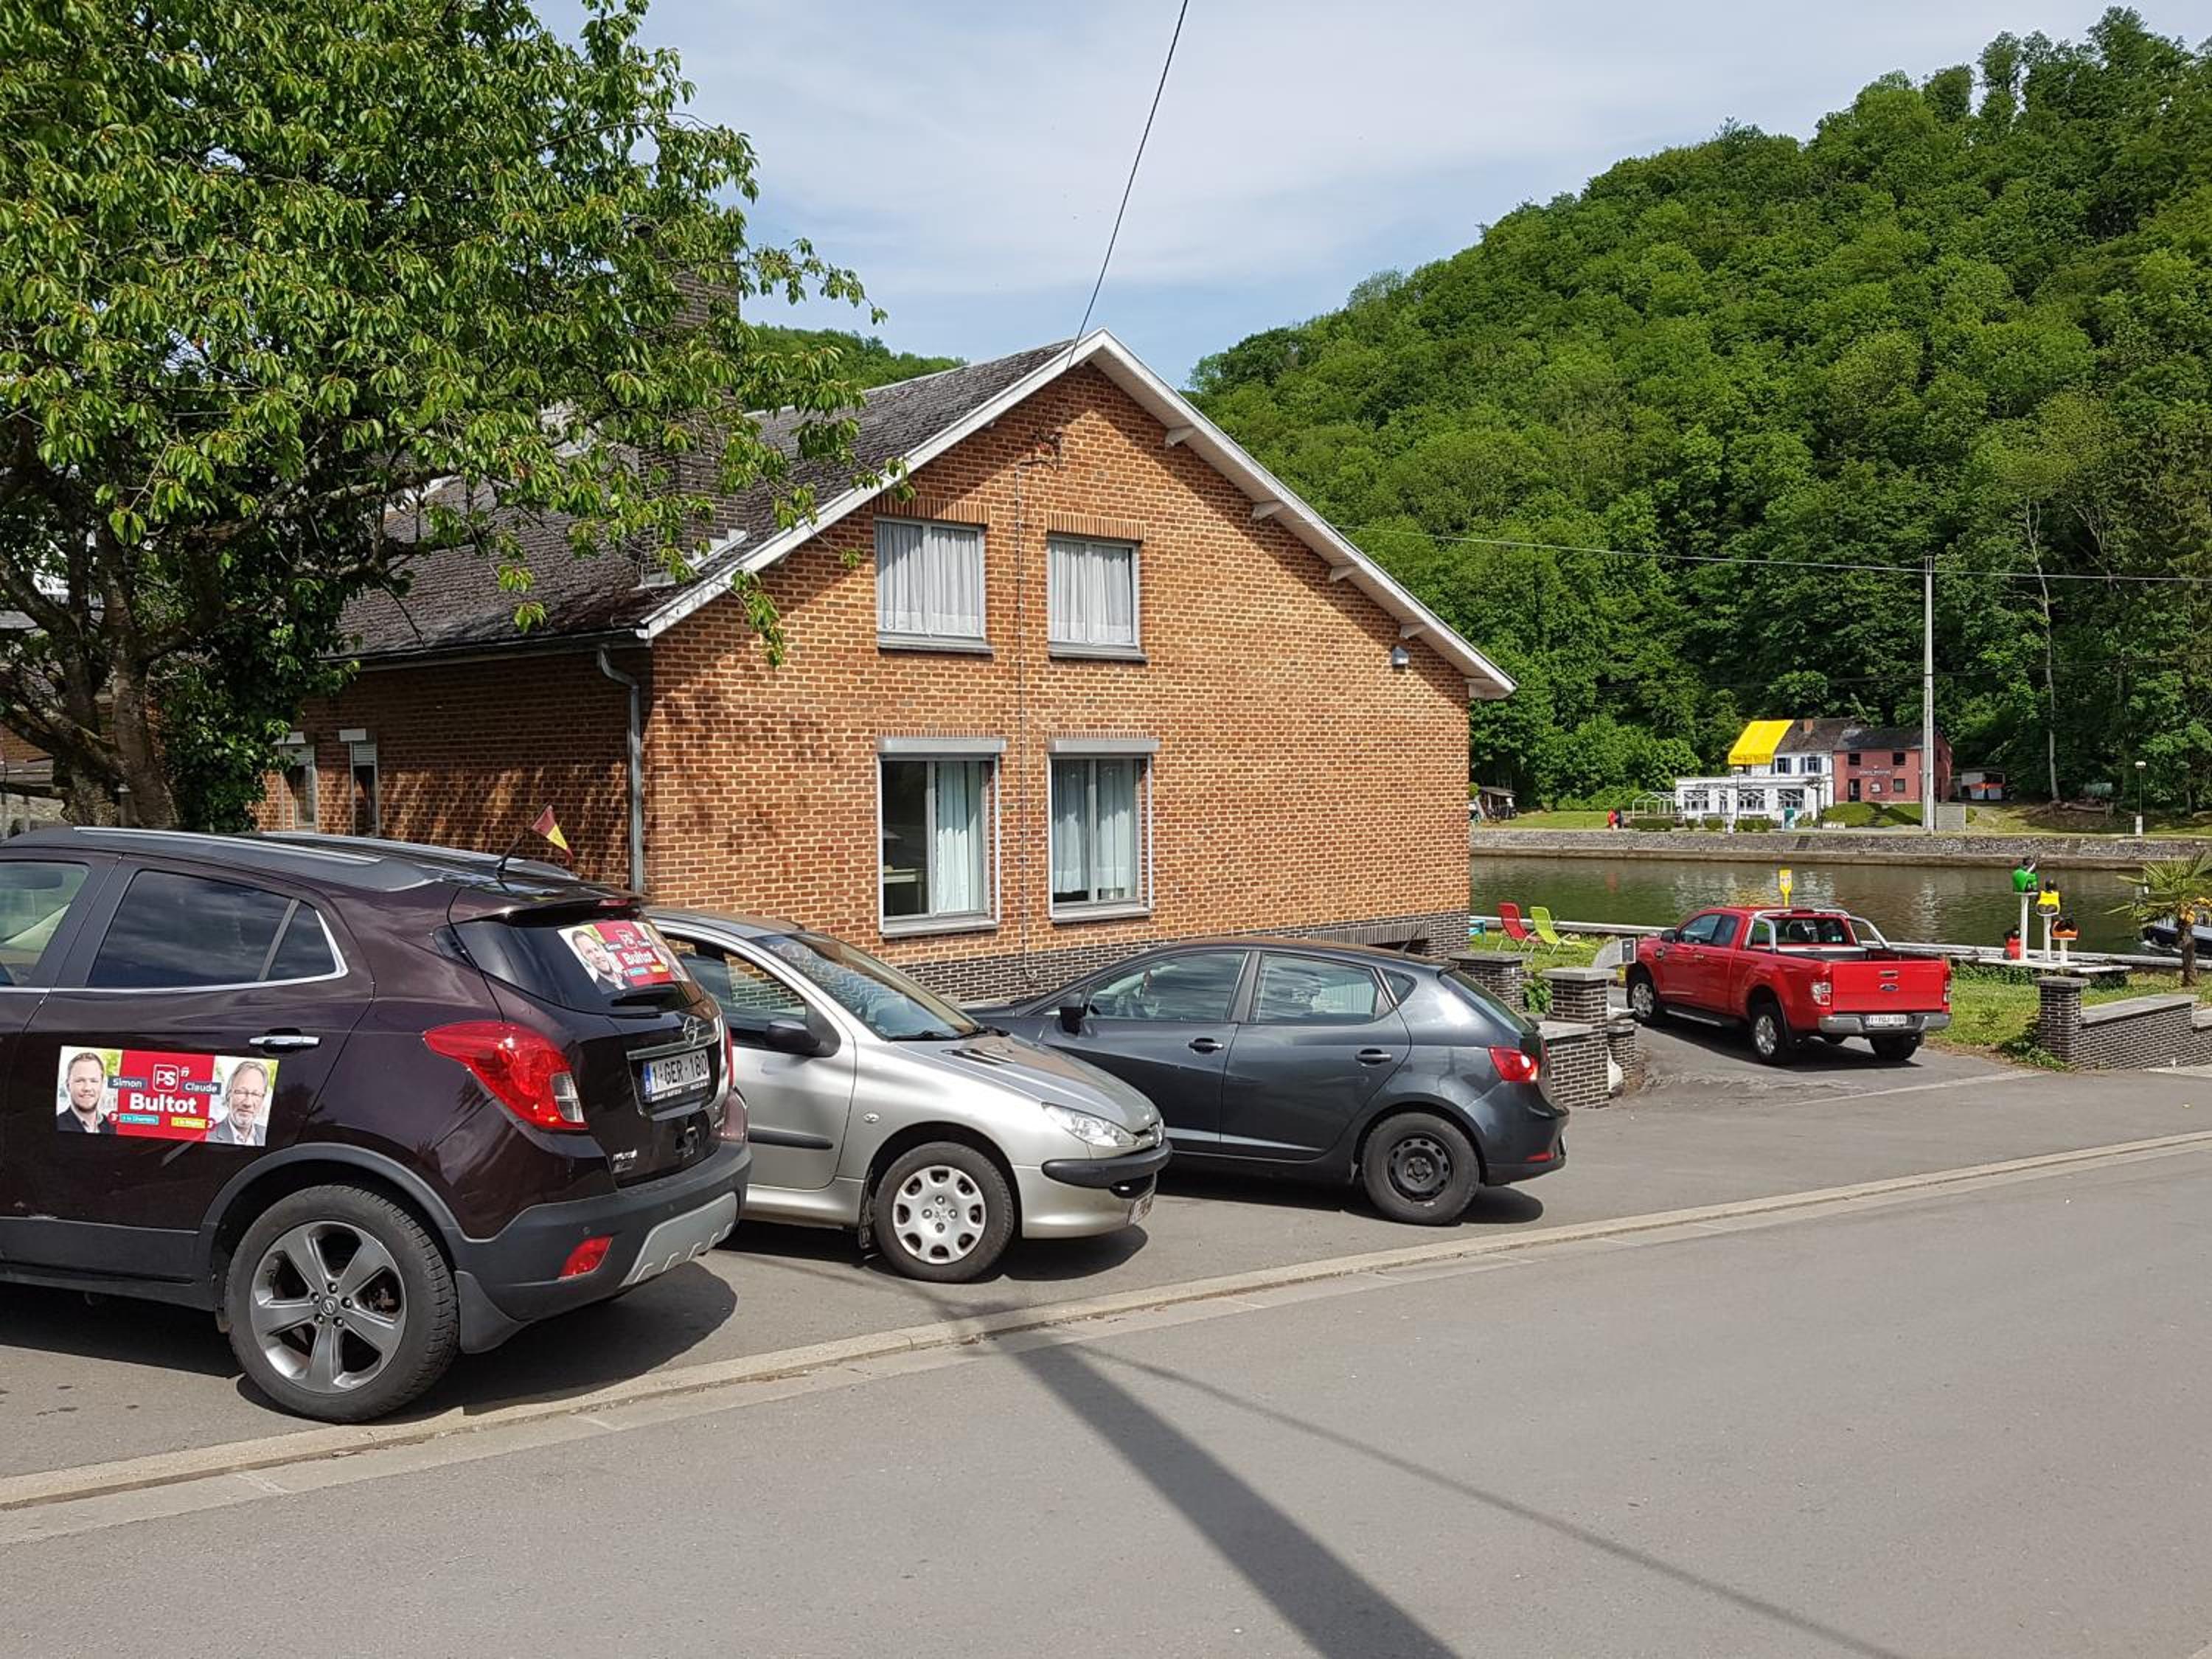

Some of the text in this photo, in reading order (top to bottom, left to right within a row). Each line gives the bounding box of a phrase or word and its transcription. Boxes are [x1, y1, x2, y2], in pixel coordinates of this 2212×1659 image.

[112, 1077, 142, 1088] Simon
[156, 1070, 176, 1086] PS
[185, 1082, 218, 1092] Claude
[129, 1092, 197, 1114] Bultot
